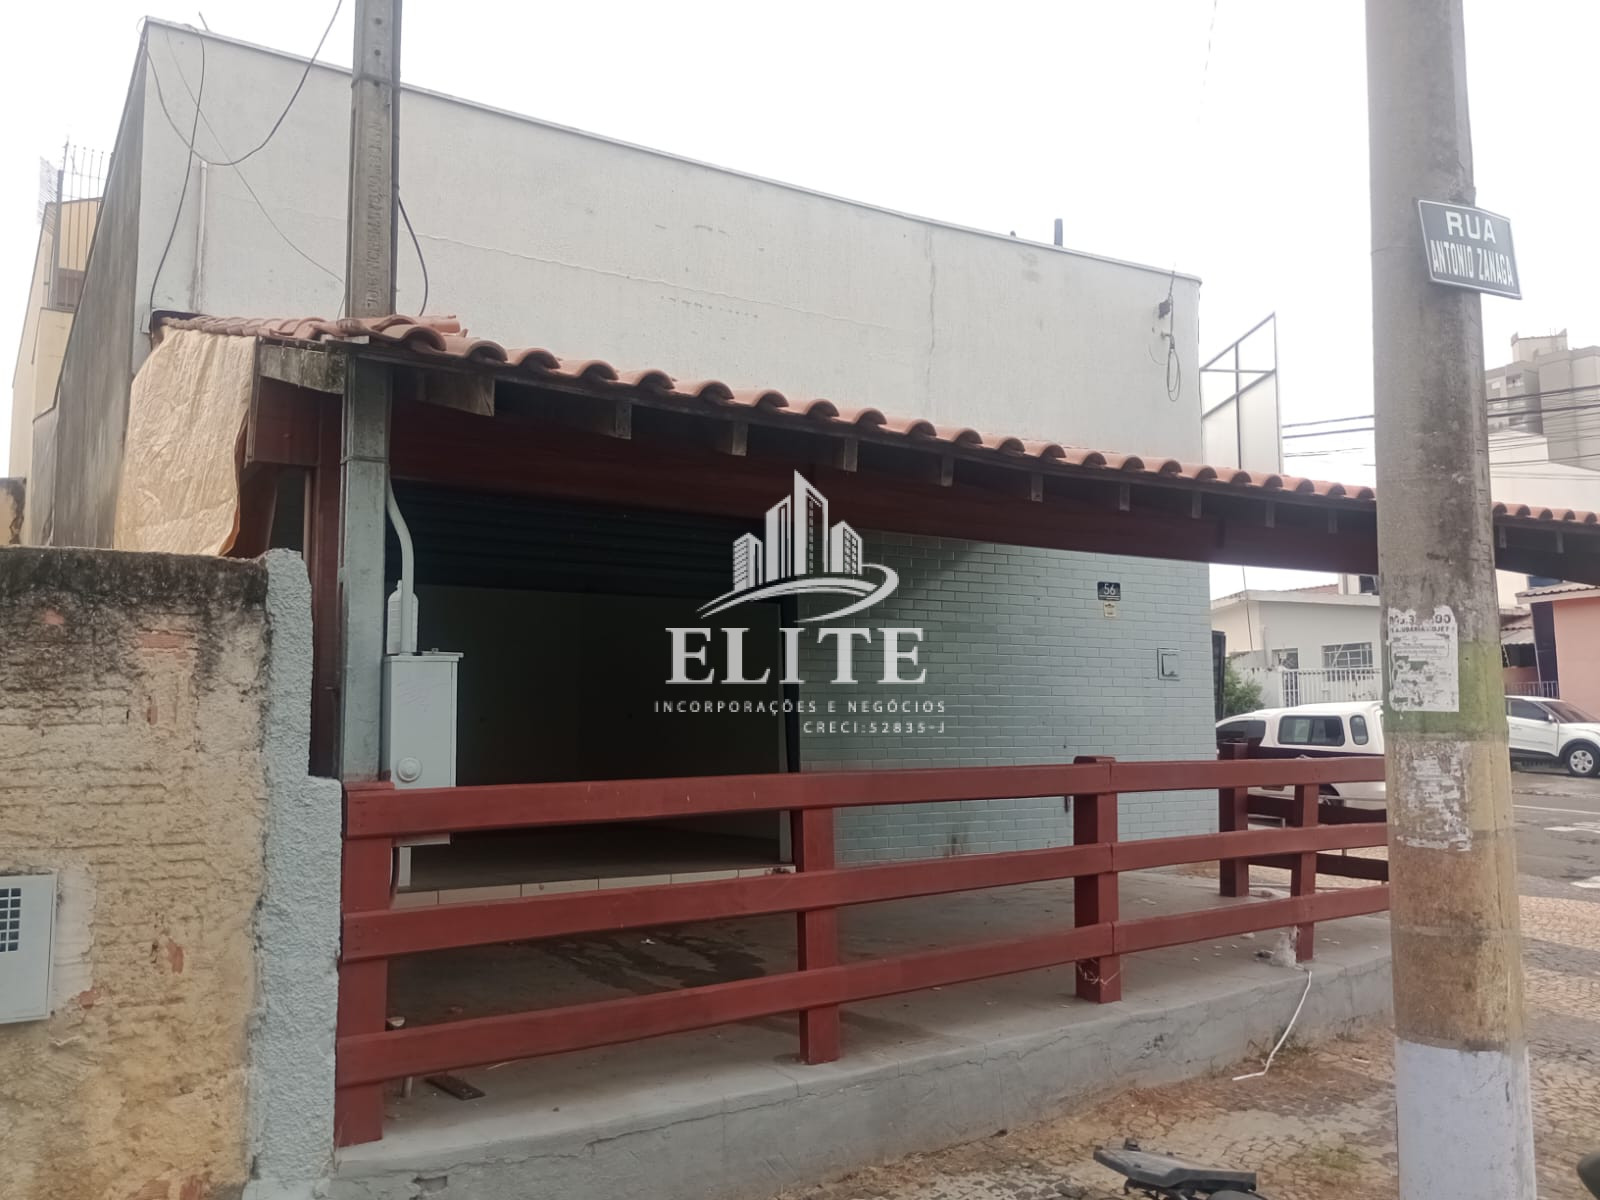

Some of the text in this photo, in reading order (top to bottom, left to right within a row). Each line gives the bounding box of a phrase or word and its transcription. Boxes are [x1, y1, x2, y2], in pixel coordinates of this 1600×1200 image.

[1445, 212, 1496, 243] RUA
[1430, 240, 1474, 278] ANTONIO
[1104, 583, 1116, 595] 56
